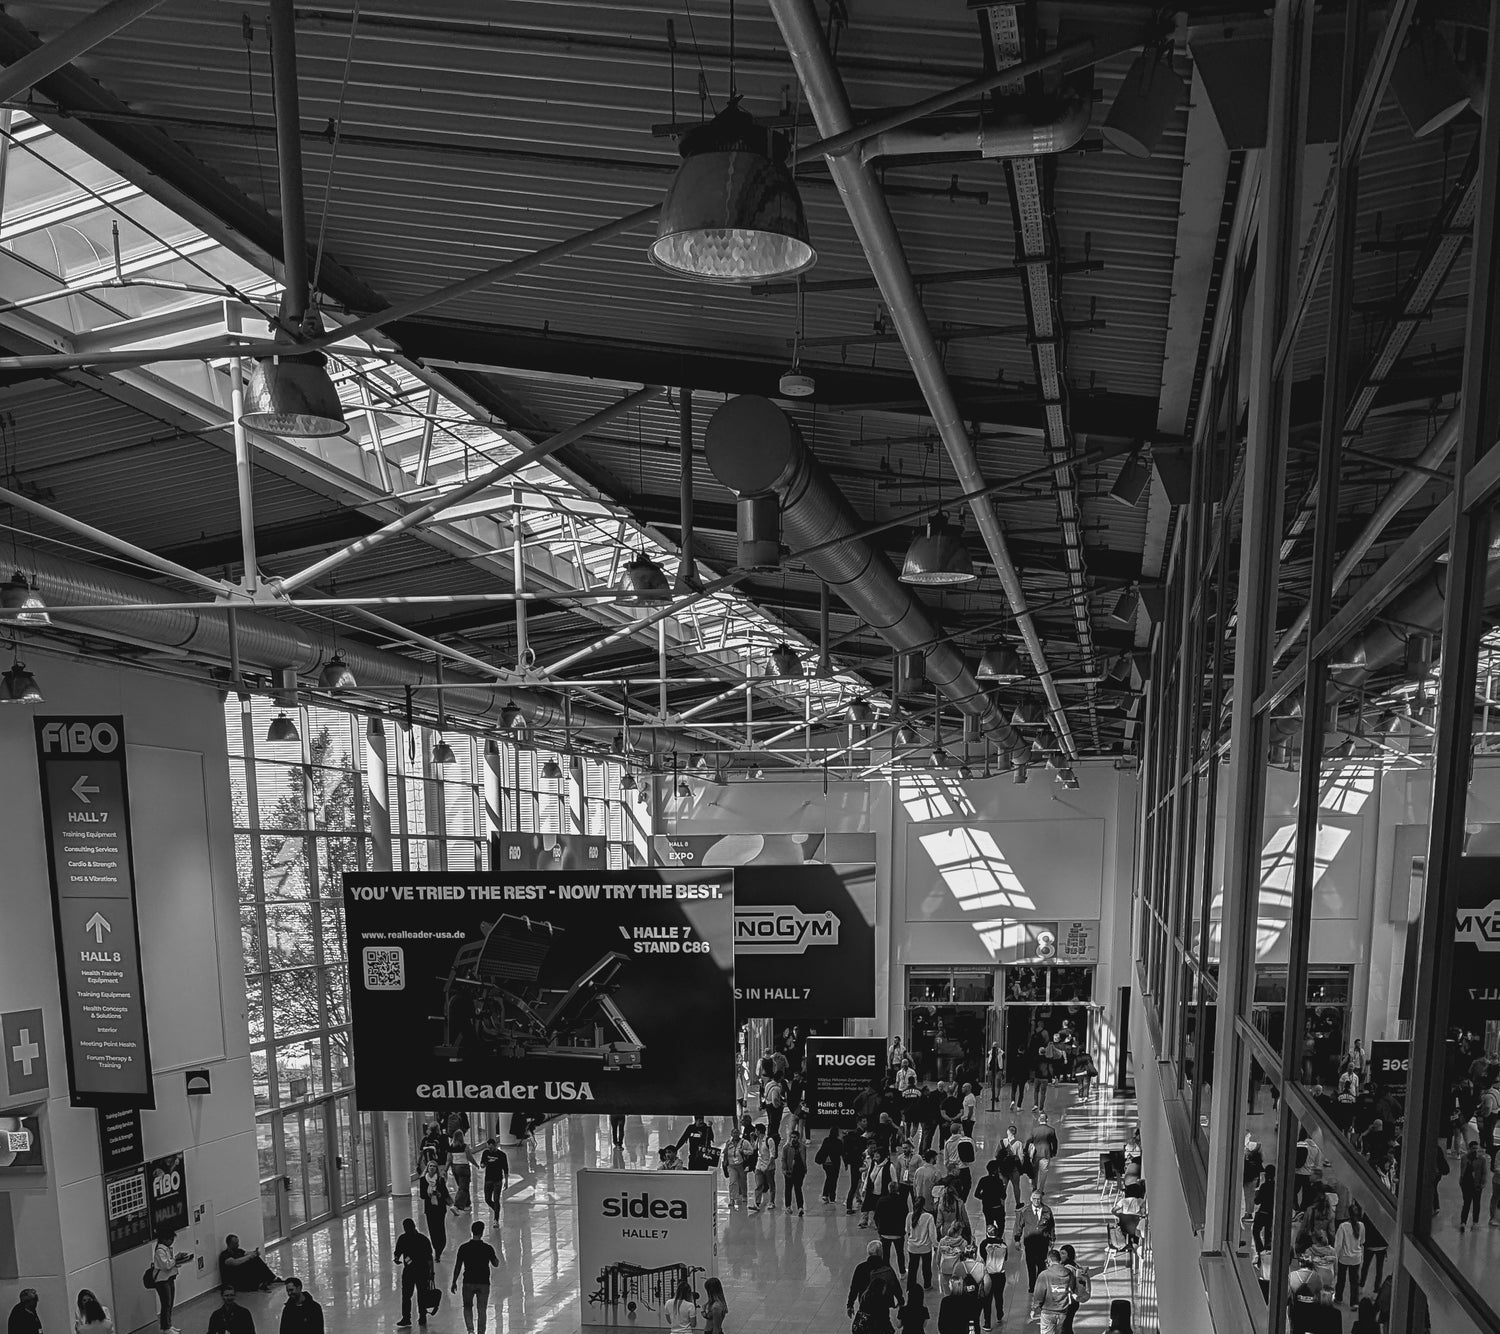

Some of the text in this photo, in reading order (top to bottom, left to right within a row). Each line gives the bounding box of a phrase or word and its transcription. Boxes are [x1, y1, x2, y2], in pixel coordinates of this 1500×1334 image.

[42, 722, 119, 753] FIBO
[68, 812, 108, 822] HALL 7
[669, 852, 694, 860] EXPO
[416, 886, 465, 900] TRIED
[467, 886, 501, 900] THE
[503, 885, 547, 900] REST
[558, 885, 600, 899] NOW
[602, 884, 637, 899] TRY
[638, 884, 673, 899] THE
[675, 884, 723, 899] BEST.
[634, 927, 691, 938] HALLE 7
[735, 915, 832, 944] NOGYM
[634, 941, 710, 954] STAND C86
[1036, 931, 1055, 958] 8
[81, 952, 121, 962] HALL 8
[746, 988, 760, 1000] IN
[764, 988, 800, 1000] HALL
[803, 988, 811, 1000] 7
[105, 1055, 127, 1063] Therapy
[816, 1054, 876, 1066] TRUGGE
[99, 1062, 121, 1070] Training
[416, 1080, 595, 1100] ealleader USA
[153, 1171, 180, 1197] FIBO
[602, 1192, 688, 1220] sidea
[156, 1204, 177, 1222] HALL
[622, 1229, 669, 1239] HALLE 7
